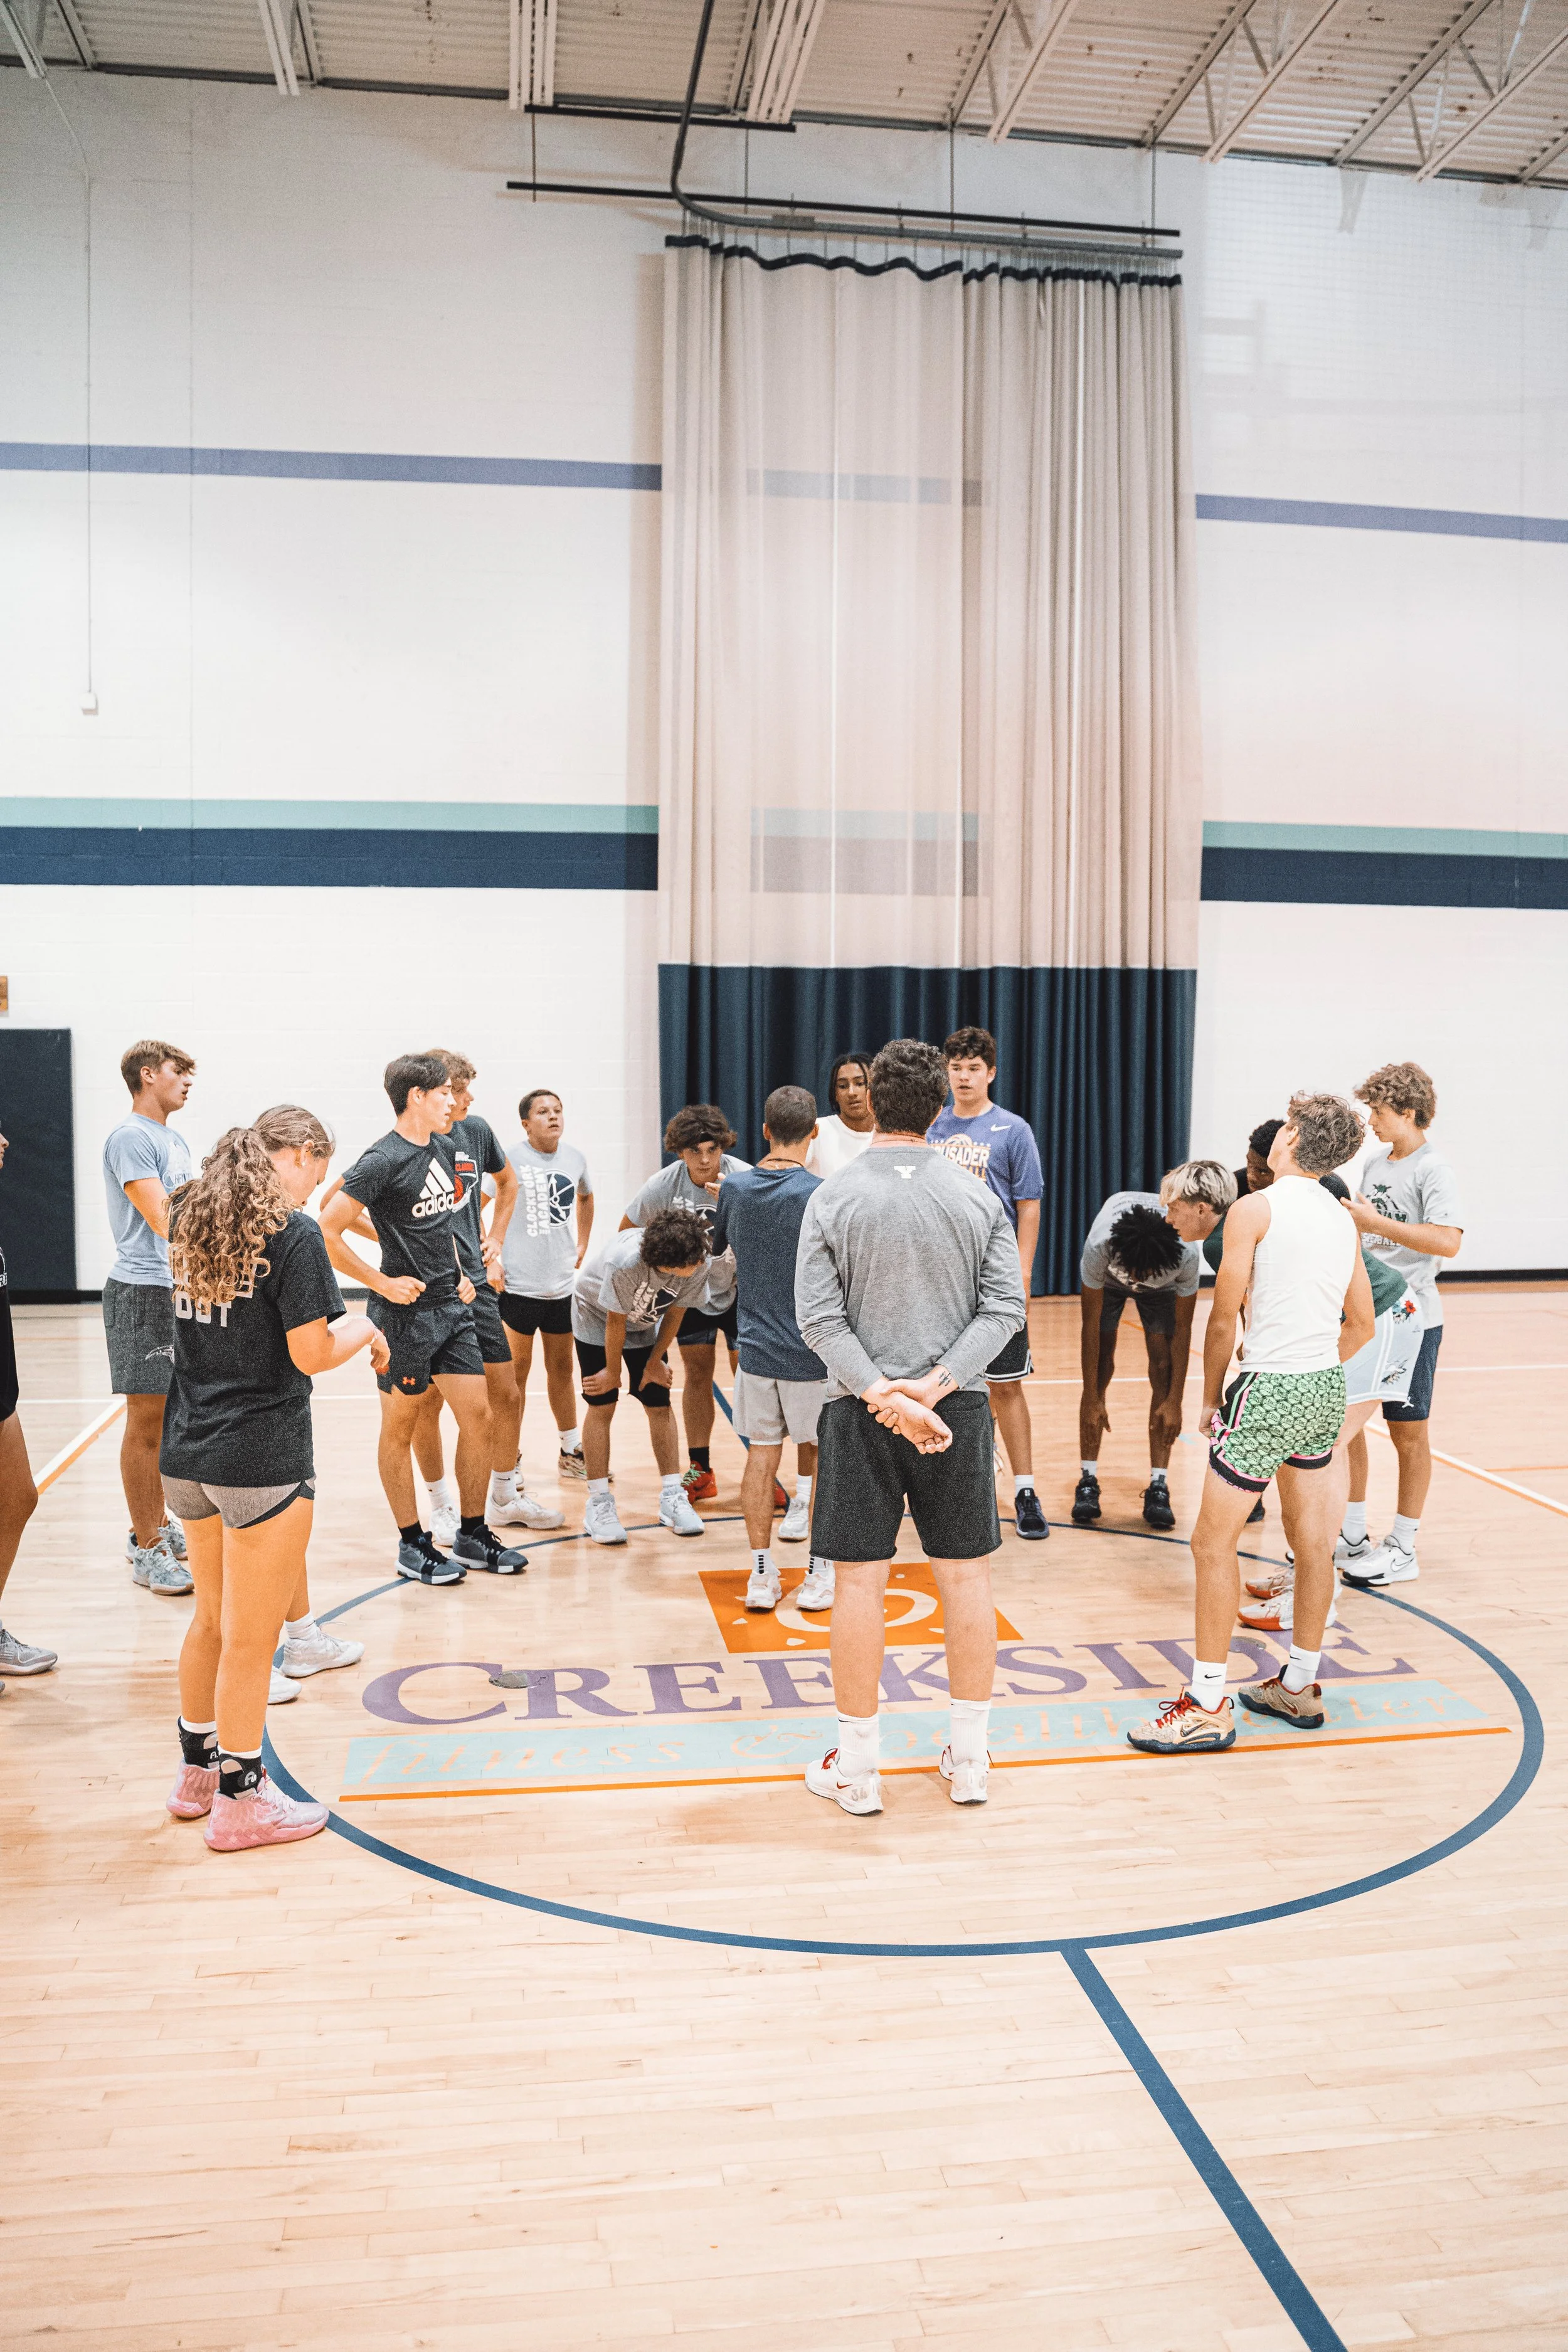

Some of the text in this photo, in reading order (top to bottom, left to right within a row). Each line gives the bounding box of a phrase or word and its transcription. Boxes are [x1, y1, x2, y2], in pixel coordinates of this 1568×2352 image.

[411, 1191, 455, 1218] adida
[519, 1165, 538, 1237] CLOCKWORK
[532, 1167, 550, 1229] ACADEMY
[362, 1620, 1418, 1725] CREEKSIDE
